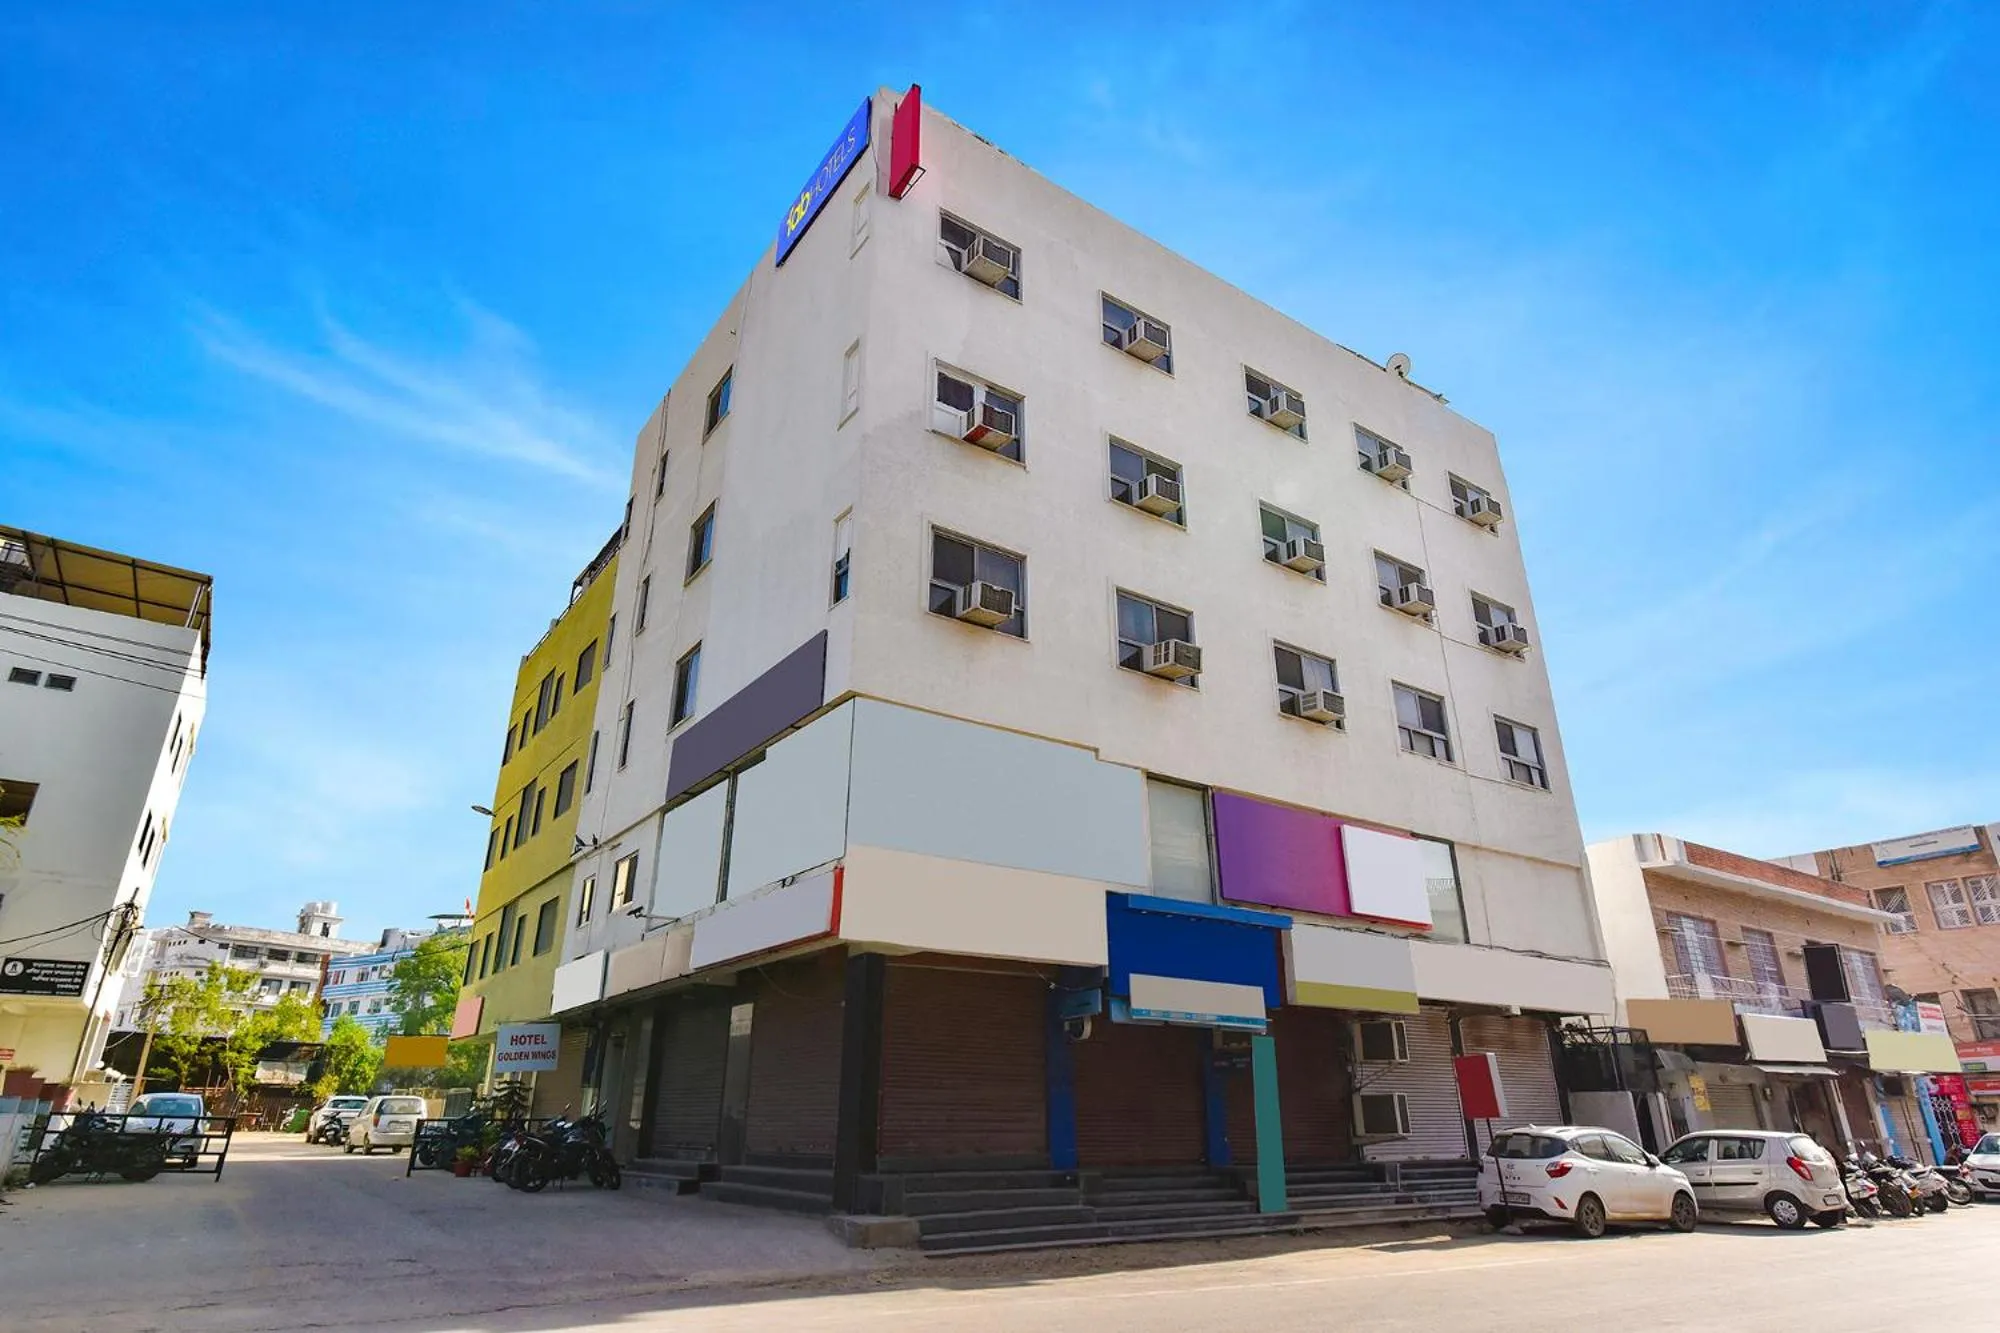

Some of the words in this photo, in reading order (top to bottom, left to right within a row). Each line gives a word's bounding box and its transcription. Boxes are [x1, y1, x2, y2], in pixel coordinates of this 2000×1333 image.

[510, 1034, 548, 1046] HOTEL
[498, 1051, 530, 1062] GOLDEN
[531, 1049, 557, 1060] WINGS
